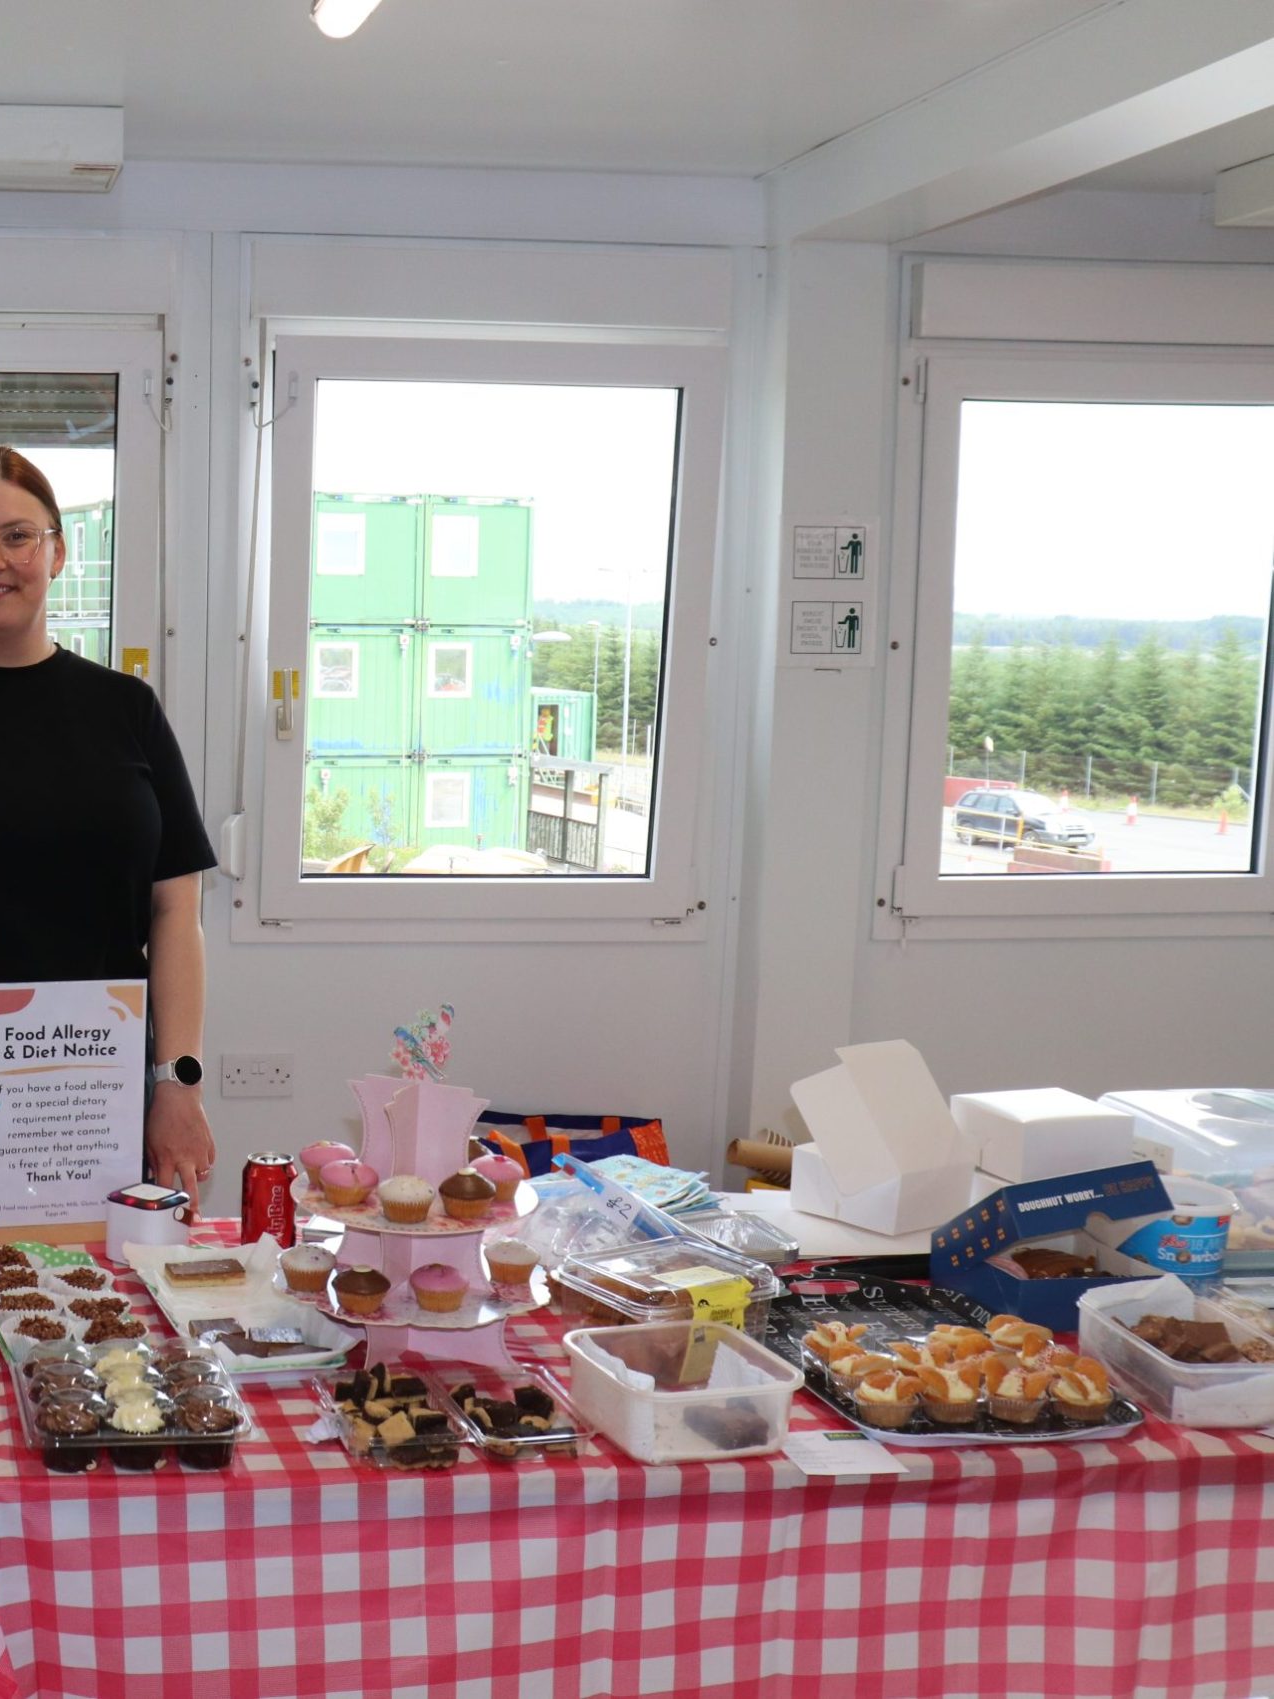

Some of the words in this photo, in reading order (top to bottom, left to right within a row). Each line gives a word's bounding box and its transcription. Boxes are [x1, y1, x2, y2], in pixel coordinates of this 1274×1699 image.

[6, 1025, 46, 1041] Food
[52, 1024, 111, 1042] Allergy
[3, 1045, 15, 1060] &
[23, 1044, 57, 1059] Diet
[64, 1043, 117, 1057] Notice
[6, 1087, 24, 1096] you
[27, 1083, 51, 1093] have
[64, 1081, 87, 1092] food
[90, 1080, 124, 1092] allergy
[35, 1097, 69, 1110] special
[72, 1096, 108, 1107] dietary
[12, 1113, 72, 1125] requirement
[75, 1111, 107, 1122] please
[7, 1128, 57, 1140] remember
[77, 1127, 110, 1137] cannot
[53, 1143, 73, 1152] that
[76, 1140, 119, 1152] anything
[8, 1161, 16, 1170] is
[19, 1159, 39, 1169] free
[42, 1158, 53, 1168] of
[26, 1171, 62, 1183] Thank
[66, 1169, 92, 1181] You!
[1017, 1195, 1064, 1213] DOUGHNUT
[862, 1285, 927, 1331] SUPPER
